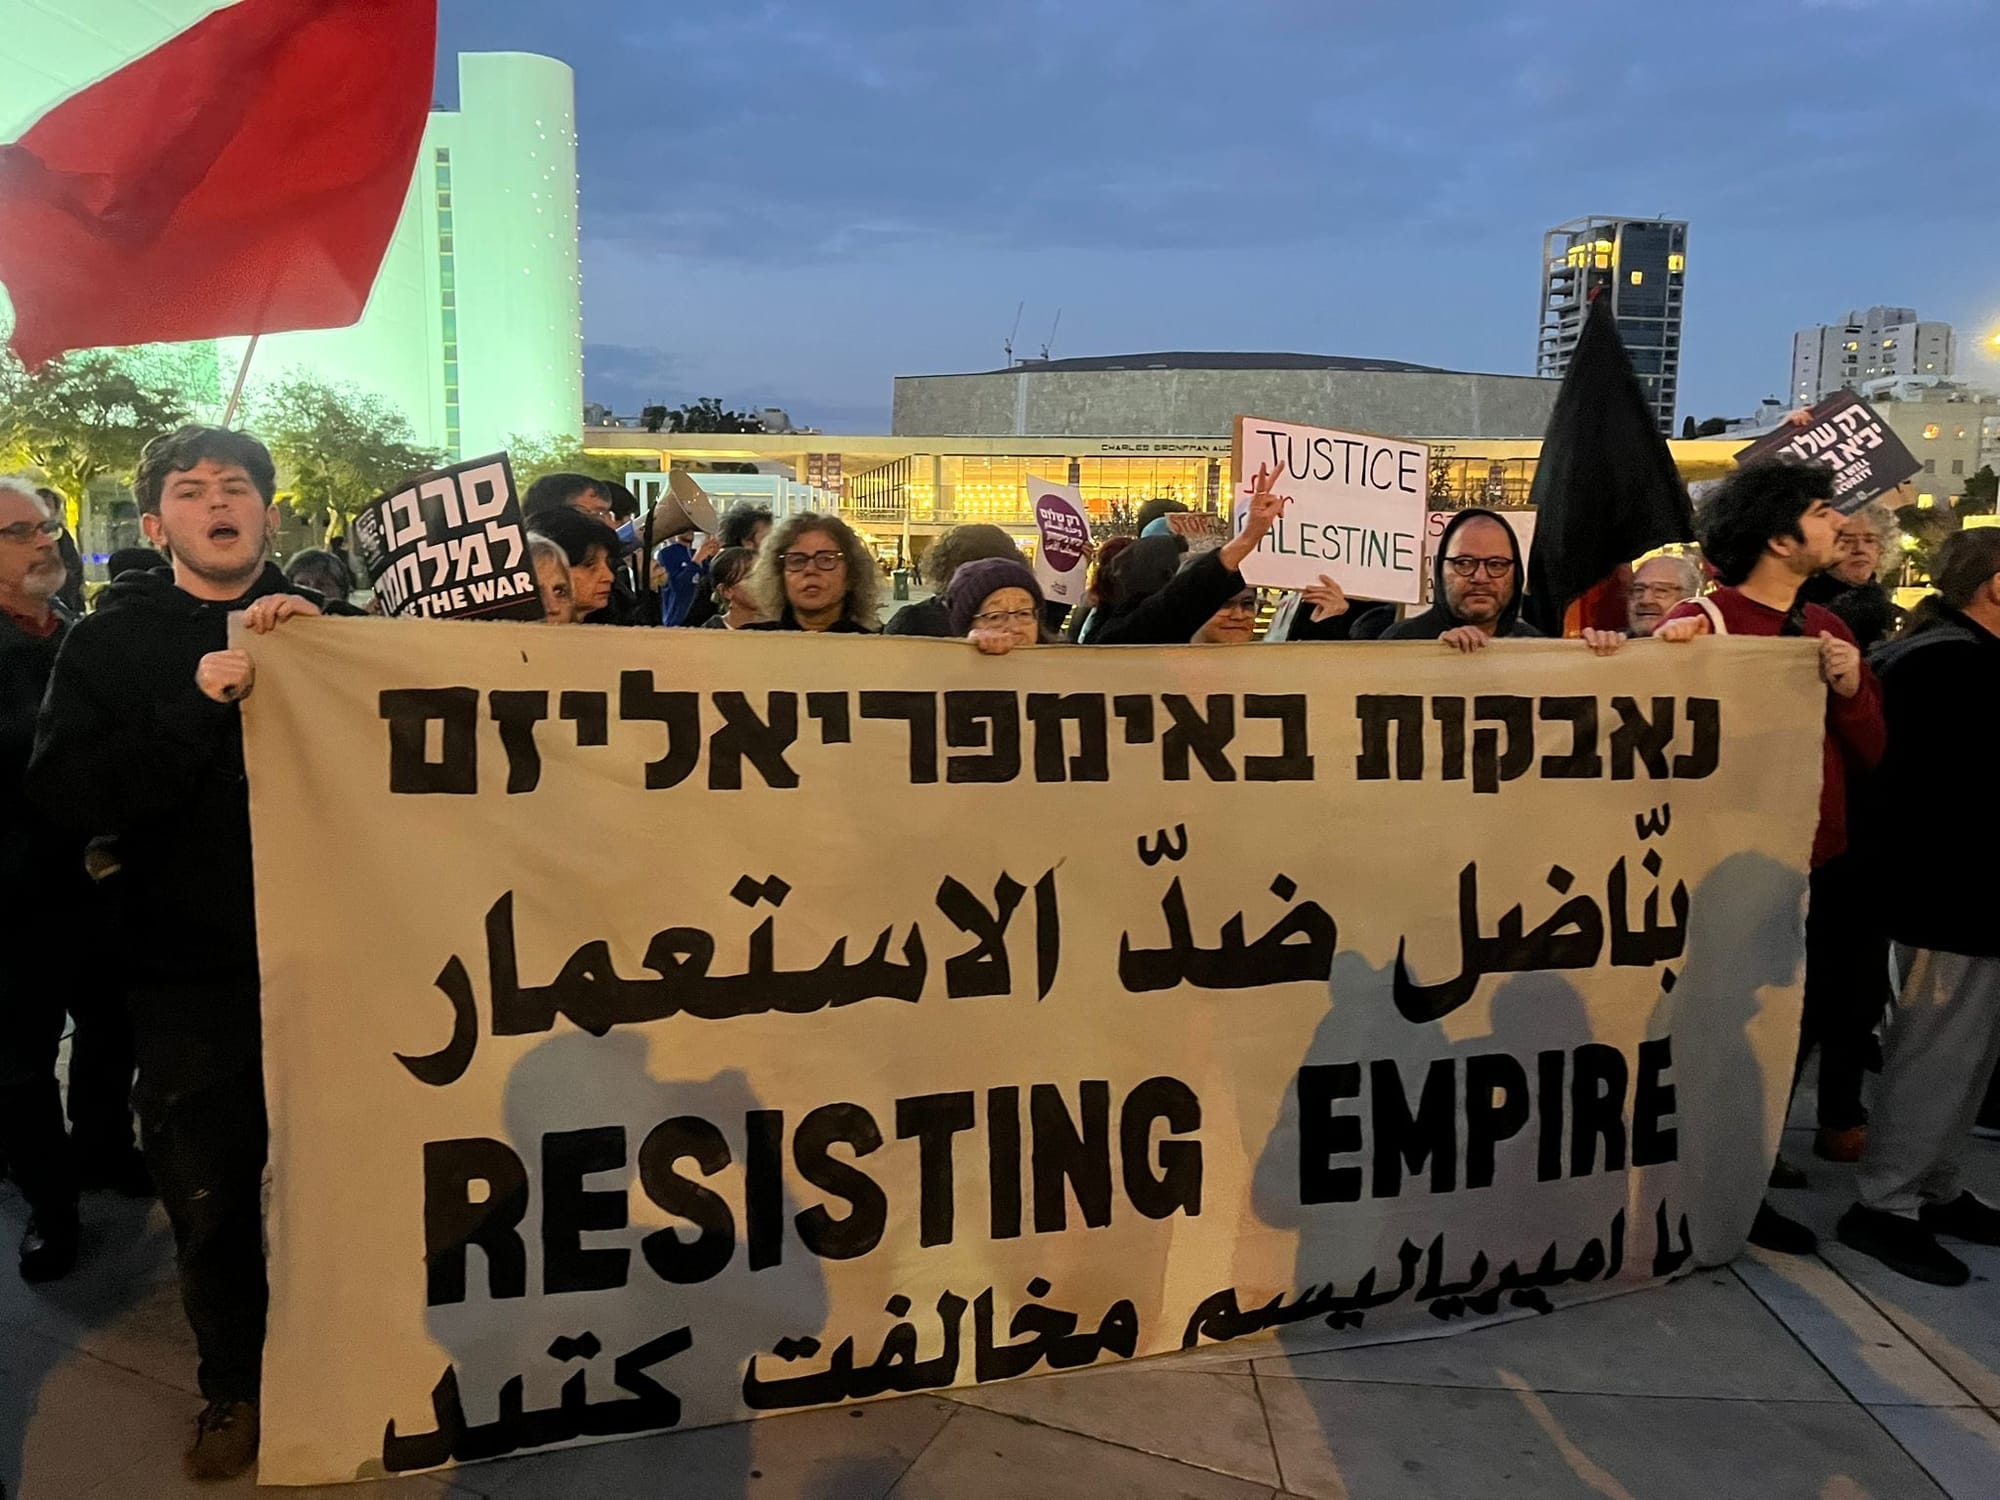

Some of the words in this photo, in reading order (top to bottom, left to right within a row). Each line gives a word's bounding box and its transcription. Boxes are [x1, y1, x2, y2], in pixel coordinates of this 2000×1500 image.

[1255, 430, 1421, 493] JUSTICE
[1776, 422, 1838, 460] שלו
[1833, 403, 1872, 437] רק
[417, 587, 468, 617] THE
[468, 571, 535, 604] WAR
[378, 669, 1315, 794] באימפריאליזם
[1355, 694, 1721, 794] נאבקות
[392, 864, 1063, 1087] الاستعمار
[423, 1076, 1203, 1308] RESISTING
[1297, 1033, 1679, 1206] EMPIRE
[742, 1276, 1139, 1410] مخالفت
